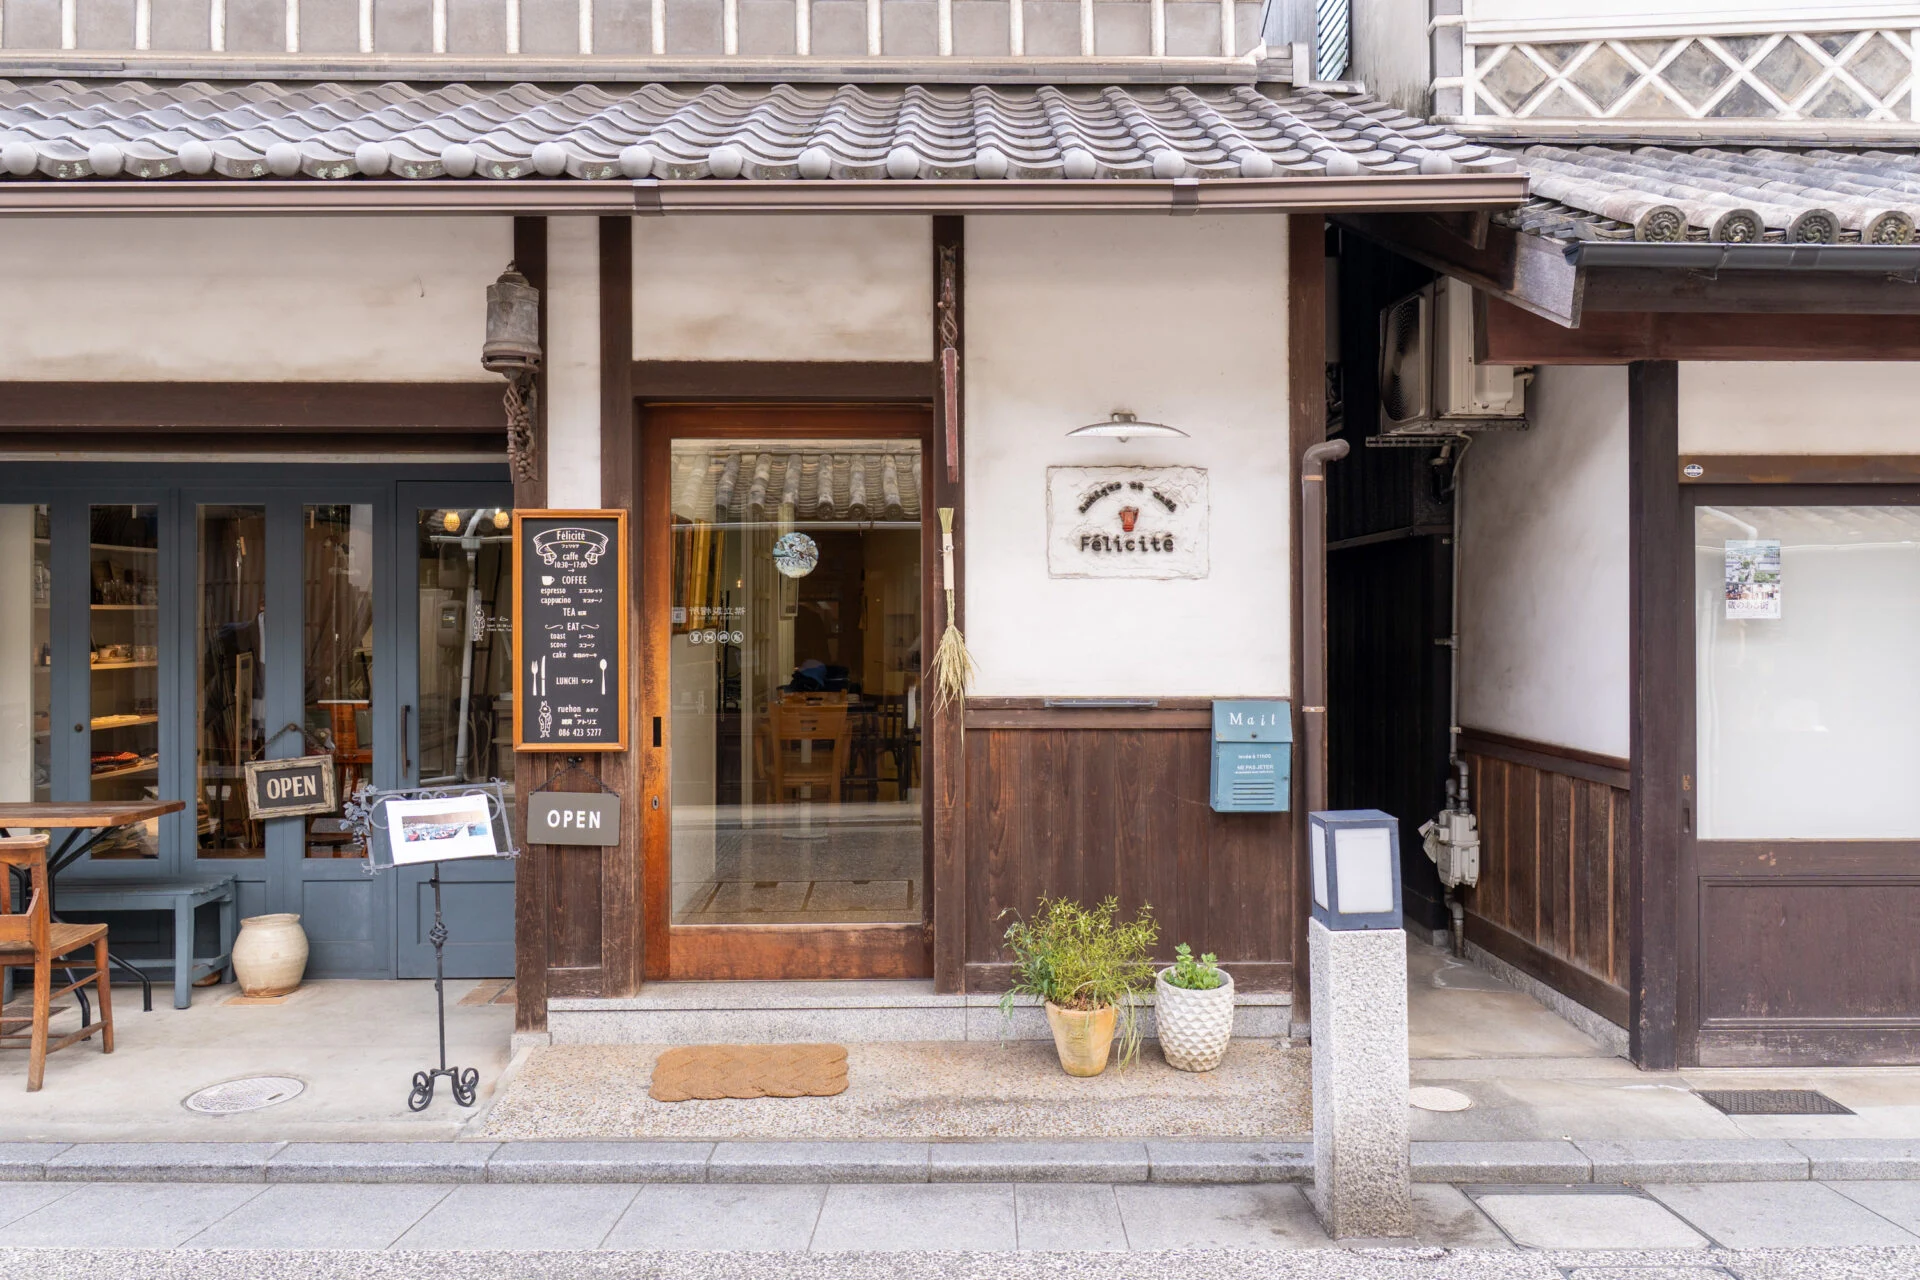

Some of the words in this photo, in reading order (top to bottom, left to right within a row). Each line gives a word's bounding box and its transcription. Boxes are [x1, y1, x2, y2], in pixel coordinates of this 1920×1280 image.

[1080, 533, 1174, 553] Félicité
[562, 575, 587, 585] COFFEE
[540, 587, 567, 596] espresso
[562, 607, 576, 617] TEA
[567, 622, 580, 631] EAT
[550, 632, 566, 640] toast
[552, 650, 567, 658] cake
[1228, 712, 1276, 726] Mail
[558, 728, 570, 737] 086
[572, 728, 584, 737] 423
[586, 728, 602, 737] 5277
[266, 775, 317, 799] OPEN
[547, 809, 601, 829] OPEN
